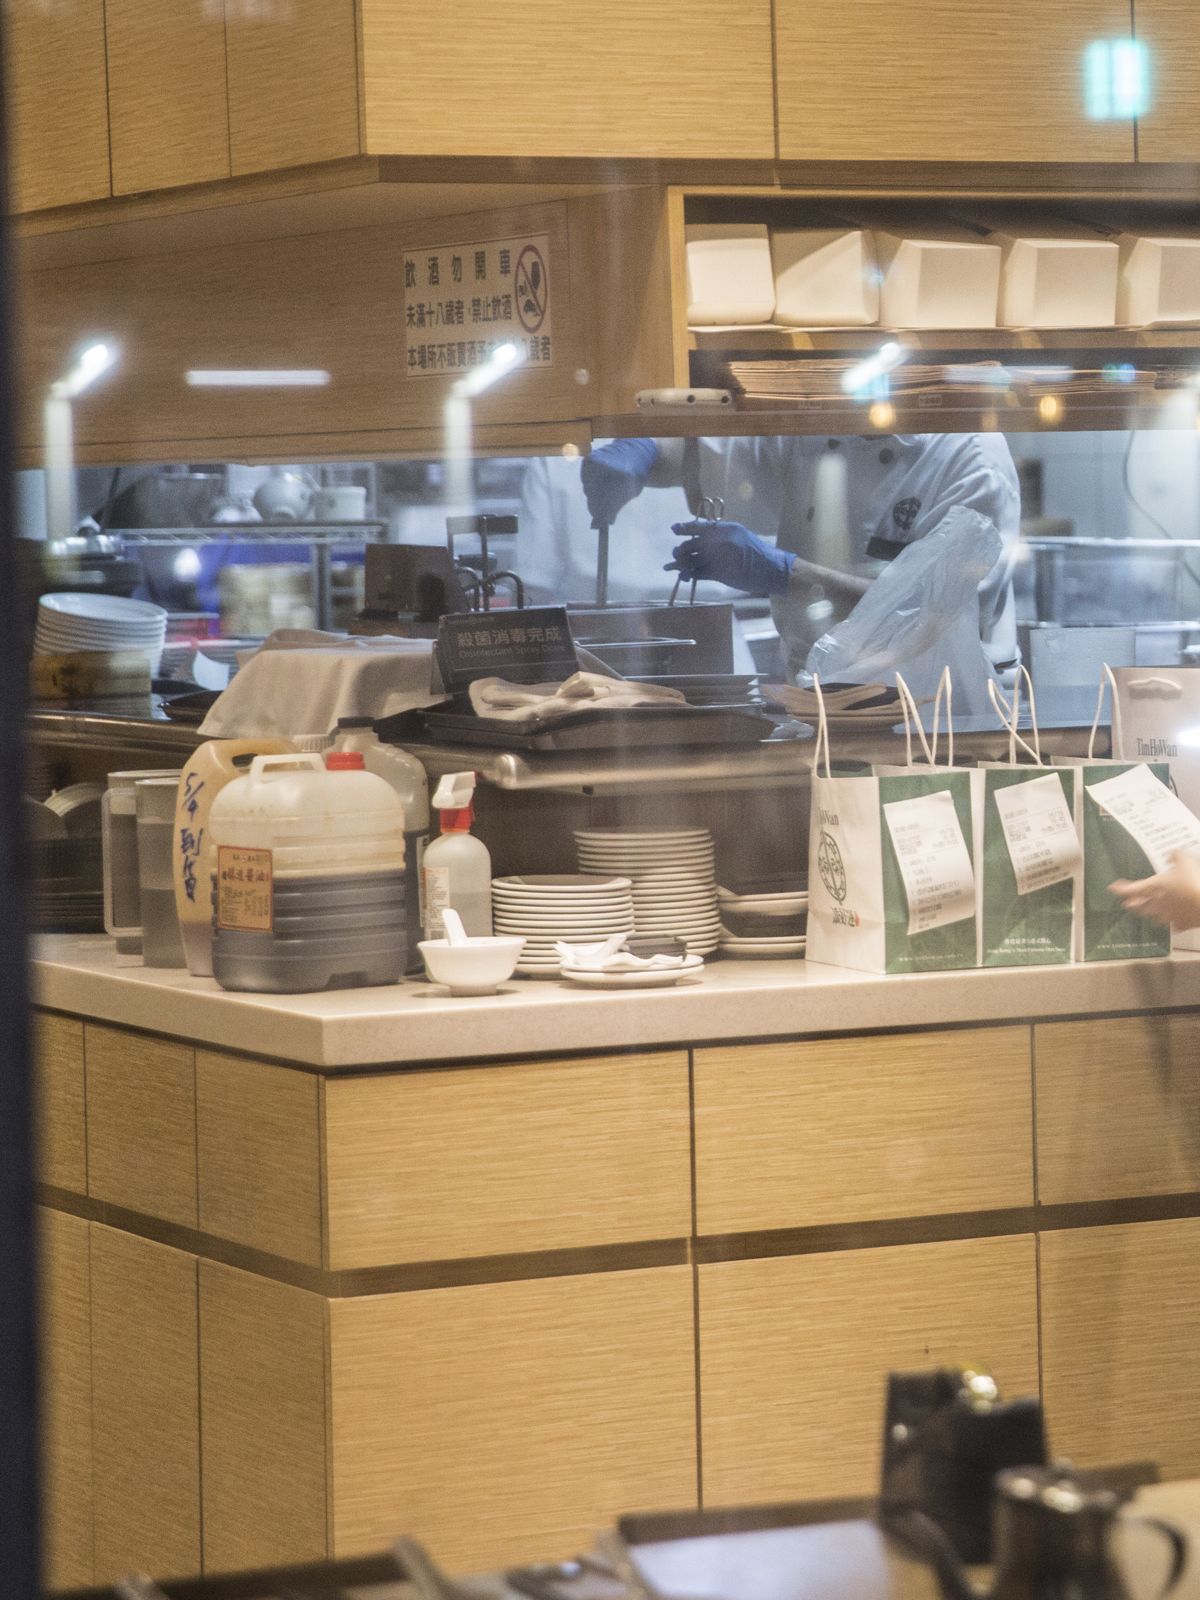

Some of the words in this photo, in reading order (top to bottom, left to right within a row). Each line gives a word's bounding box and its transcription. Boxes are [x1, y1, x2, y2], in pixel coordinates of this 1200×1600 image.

[405, 248, 511, 288] 飲酒勿開車
[457, 625, 561, 648] 殺菌消毒完成
